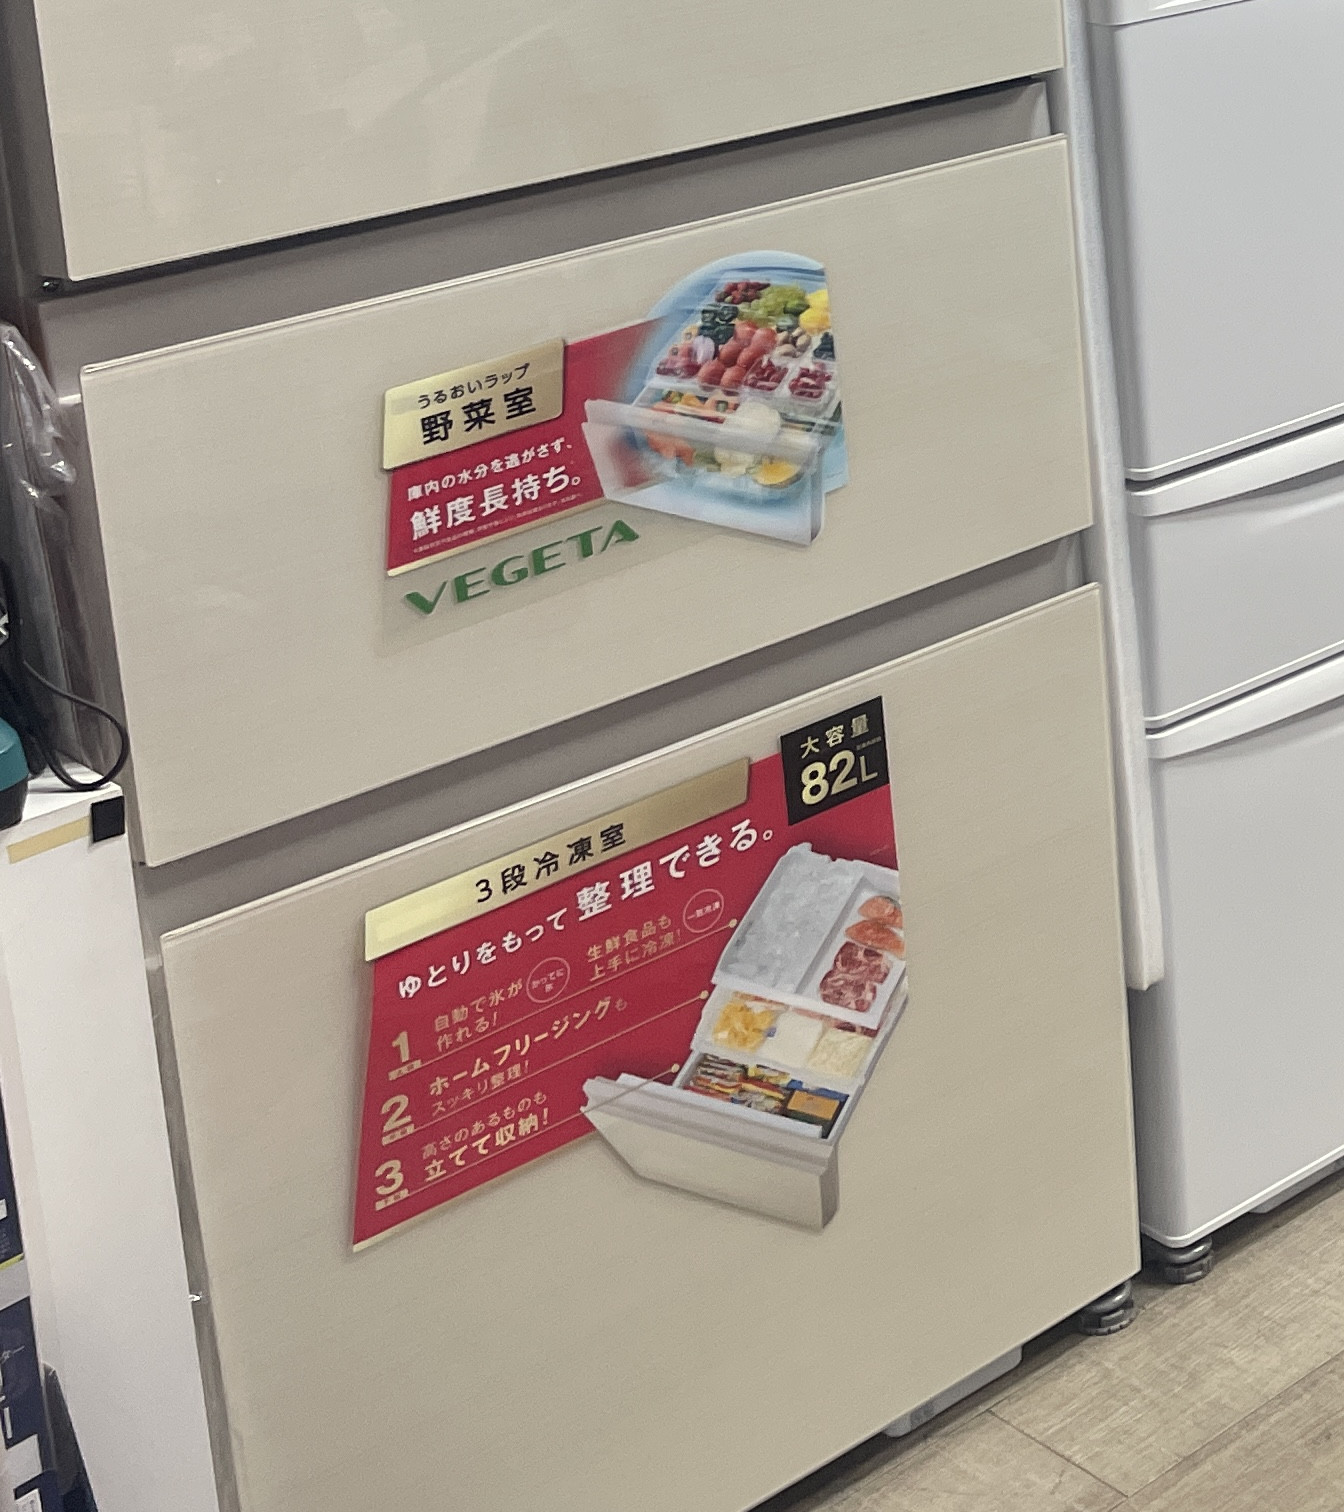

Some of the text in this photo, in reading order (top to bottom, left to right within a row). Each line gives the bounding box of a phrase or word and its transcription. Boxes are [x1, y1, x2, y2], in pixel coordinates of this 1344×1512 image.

[416, 362, 531, 409] うるおいラップ
[420, 387, 538, 447] 野菜室
[407, 437, 575, 504] 庫内の水分を逃がさず、
[409, 465, 583, 543] 鮮度長持ち。
[404, 519, 641, 618] VEGETA
[800, 712, 871, 759] 大容量
[799, 752, 879, 808] 82L
[474, 822, 629, 905] 3段冷凍室
[397, 819, 775, 1003] ゆとりをもって整理できる。
[586, 915, 673, 964] 生鮮食品も
[588, 929, 682, 983] 上手に冷凍!
[433, 979, 524, 1035] 自動で氷が
[436, 1011, 499, 1054] 作れる!
[428, 995, 630, 1097] ホームフリージングも
[431, 1059, 532, 1121] スッキリ整理!
[420, 1091, 548, 1159] 高さのあるものも
[424, 1106, 550, 1182] 立てて収納!
